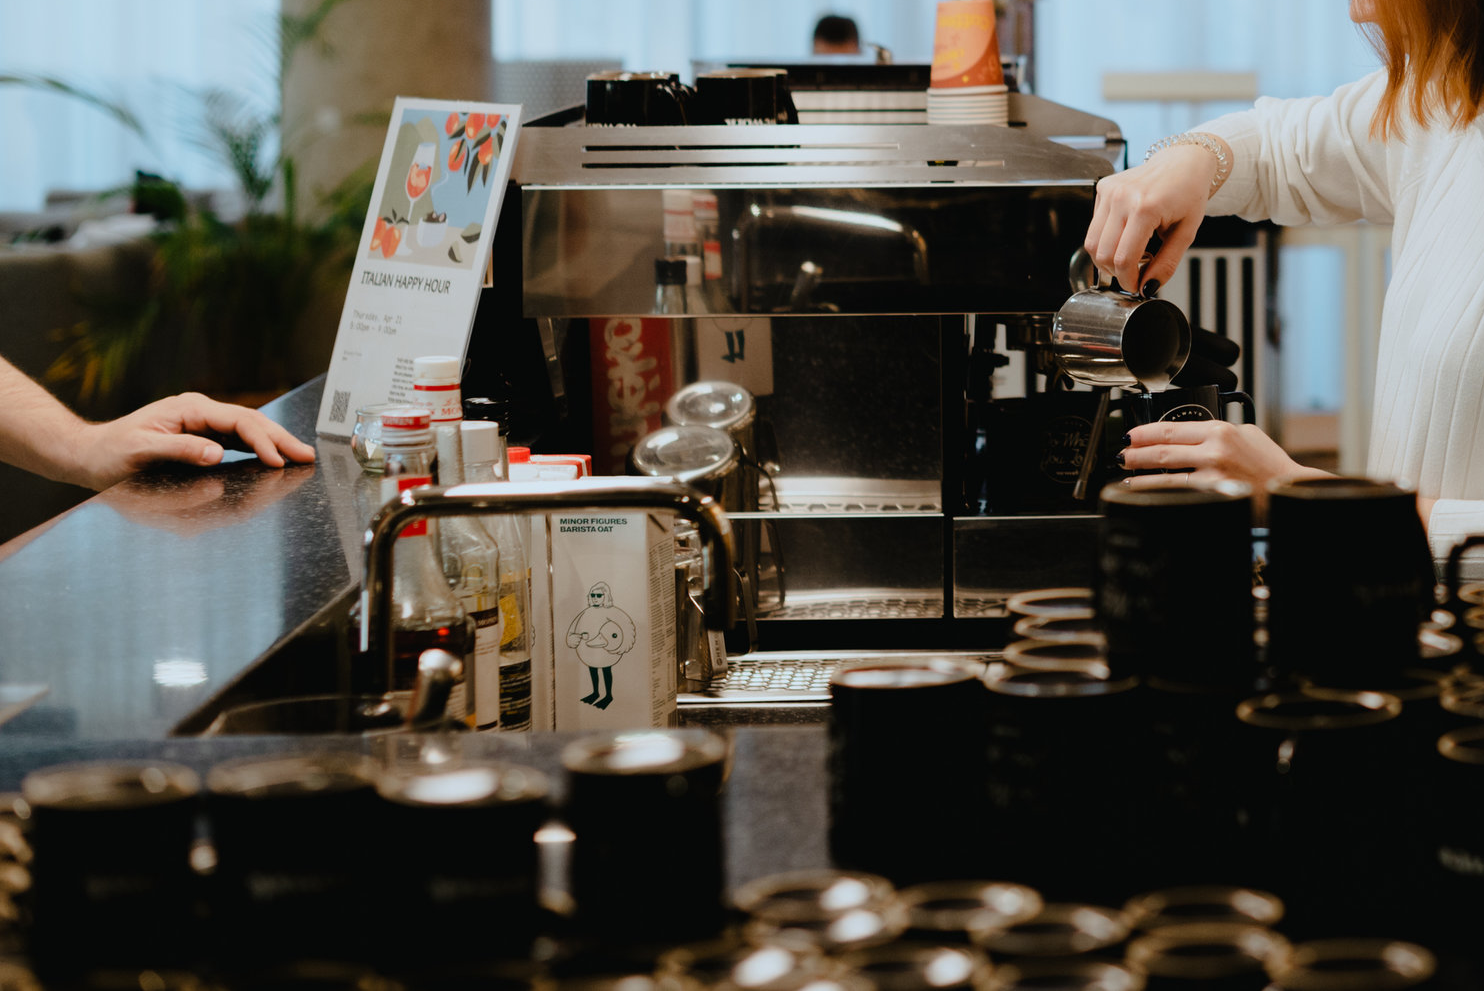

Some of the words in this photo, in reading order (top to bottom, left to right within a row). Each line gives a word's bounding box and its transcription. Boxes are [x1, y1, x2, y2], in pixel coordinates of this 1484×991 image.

[361, 271, 394, 288] ITALIAN
[395, 274, 424, 291] HAPPY
[424, 277, 451, 295] HOUR
[1171, 410, 1203, 421] ALWAYS
[559, 525, 597, 533] BARISTA
[597, 525, 613, 533] OAT
